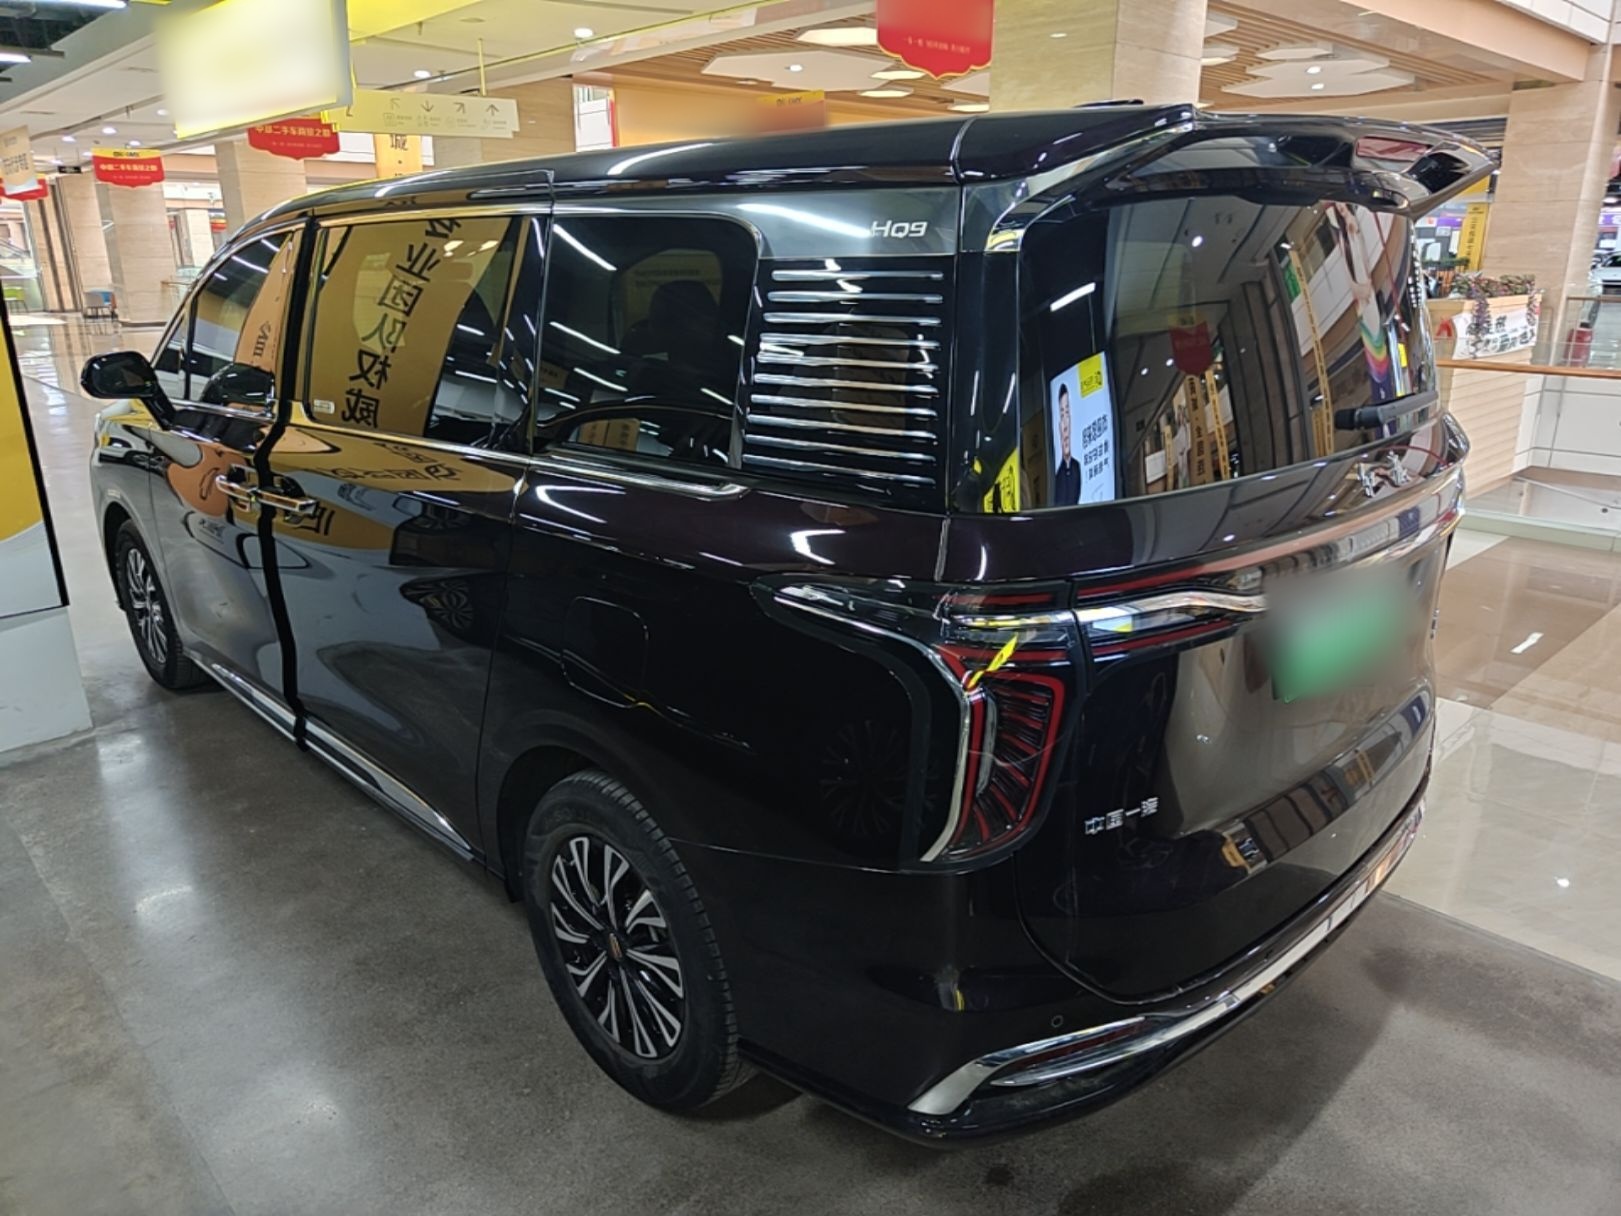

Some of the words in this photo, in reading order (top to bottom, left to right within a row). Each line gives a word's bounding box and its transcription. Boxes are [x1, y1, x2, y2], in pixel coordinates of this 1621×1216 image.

[872, 220, 928, 239] HQ9
[1084, 796, 1159, 835] 中国一汽
